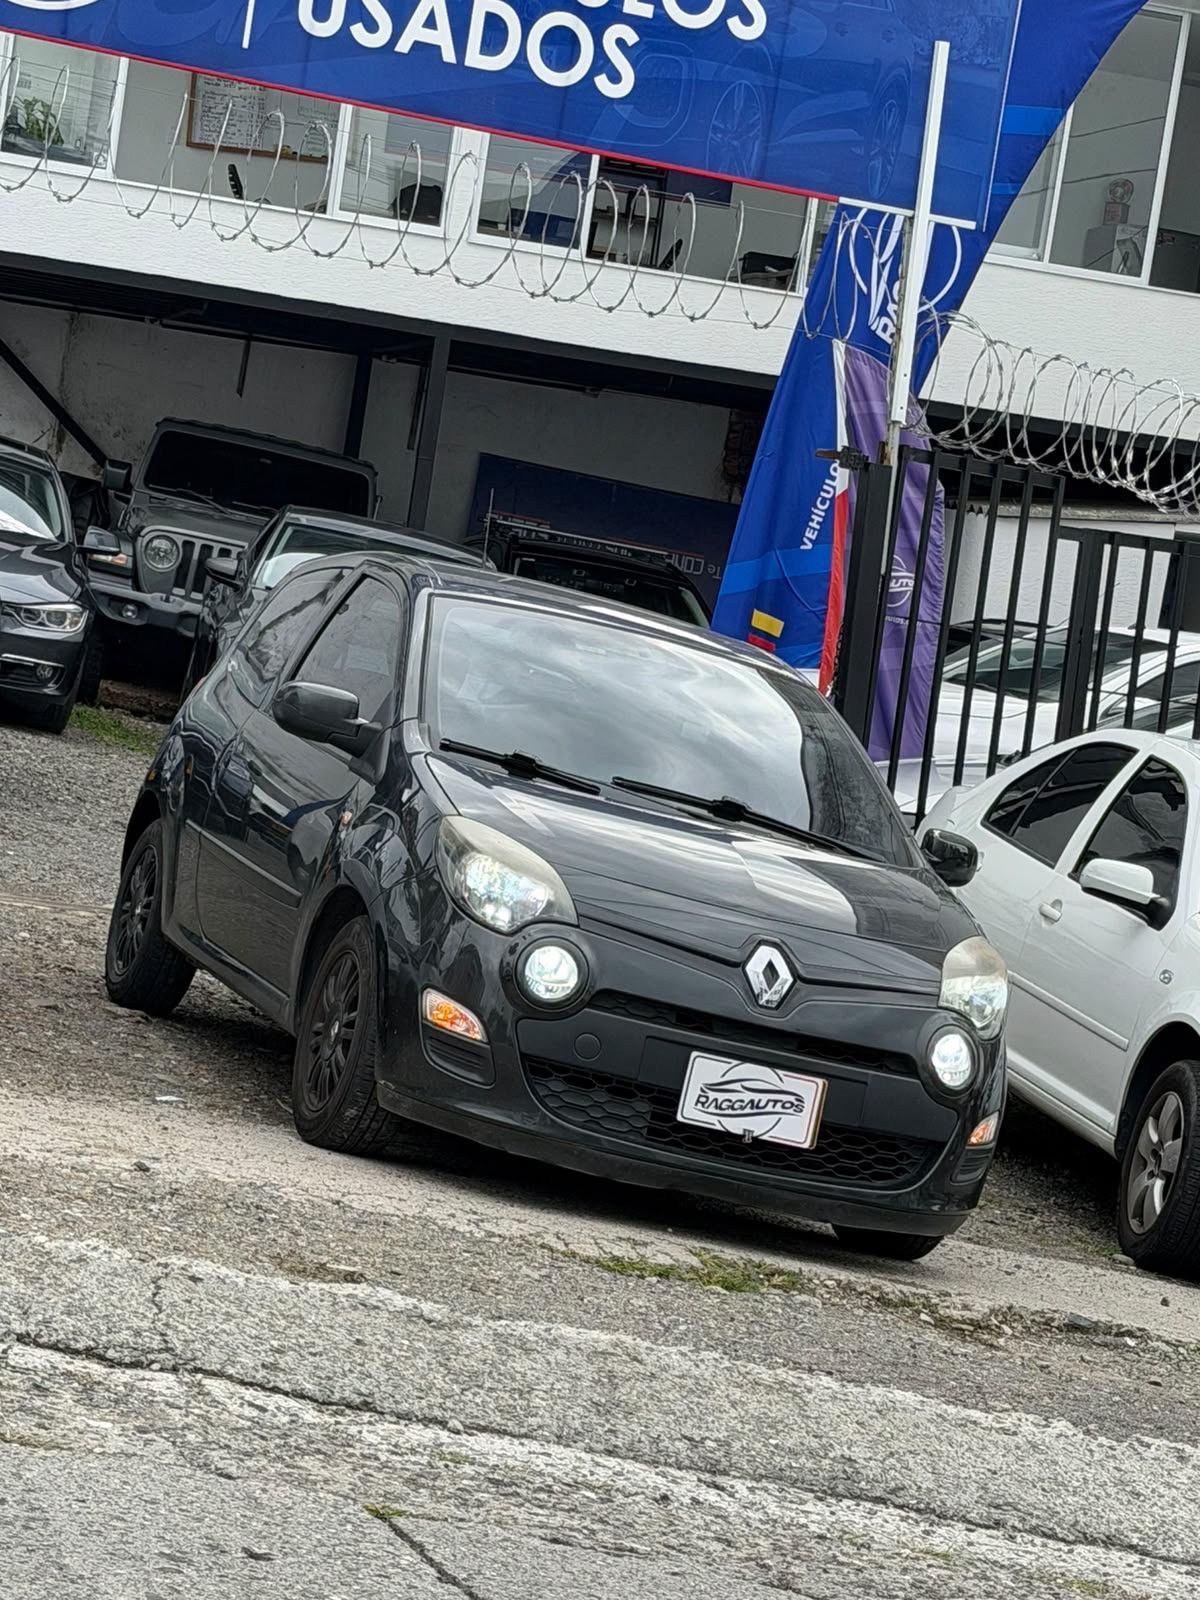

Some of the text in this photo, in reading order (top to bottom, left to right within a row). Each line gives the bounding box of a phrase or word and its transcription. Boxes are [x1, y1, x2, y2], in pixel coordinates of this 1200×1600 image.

[298, 0, 640, 99] USADOS
[800, 459, 840, 550] VEHÍCULO
[694, 1093, 805, 1114] RAGGAUTOS
